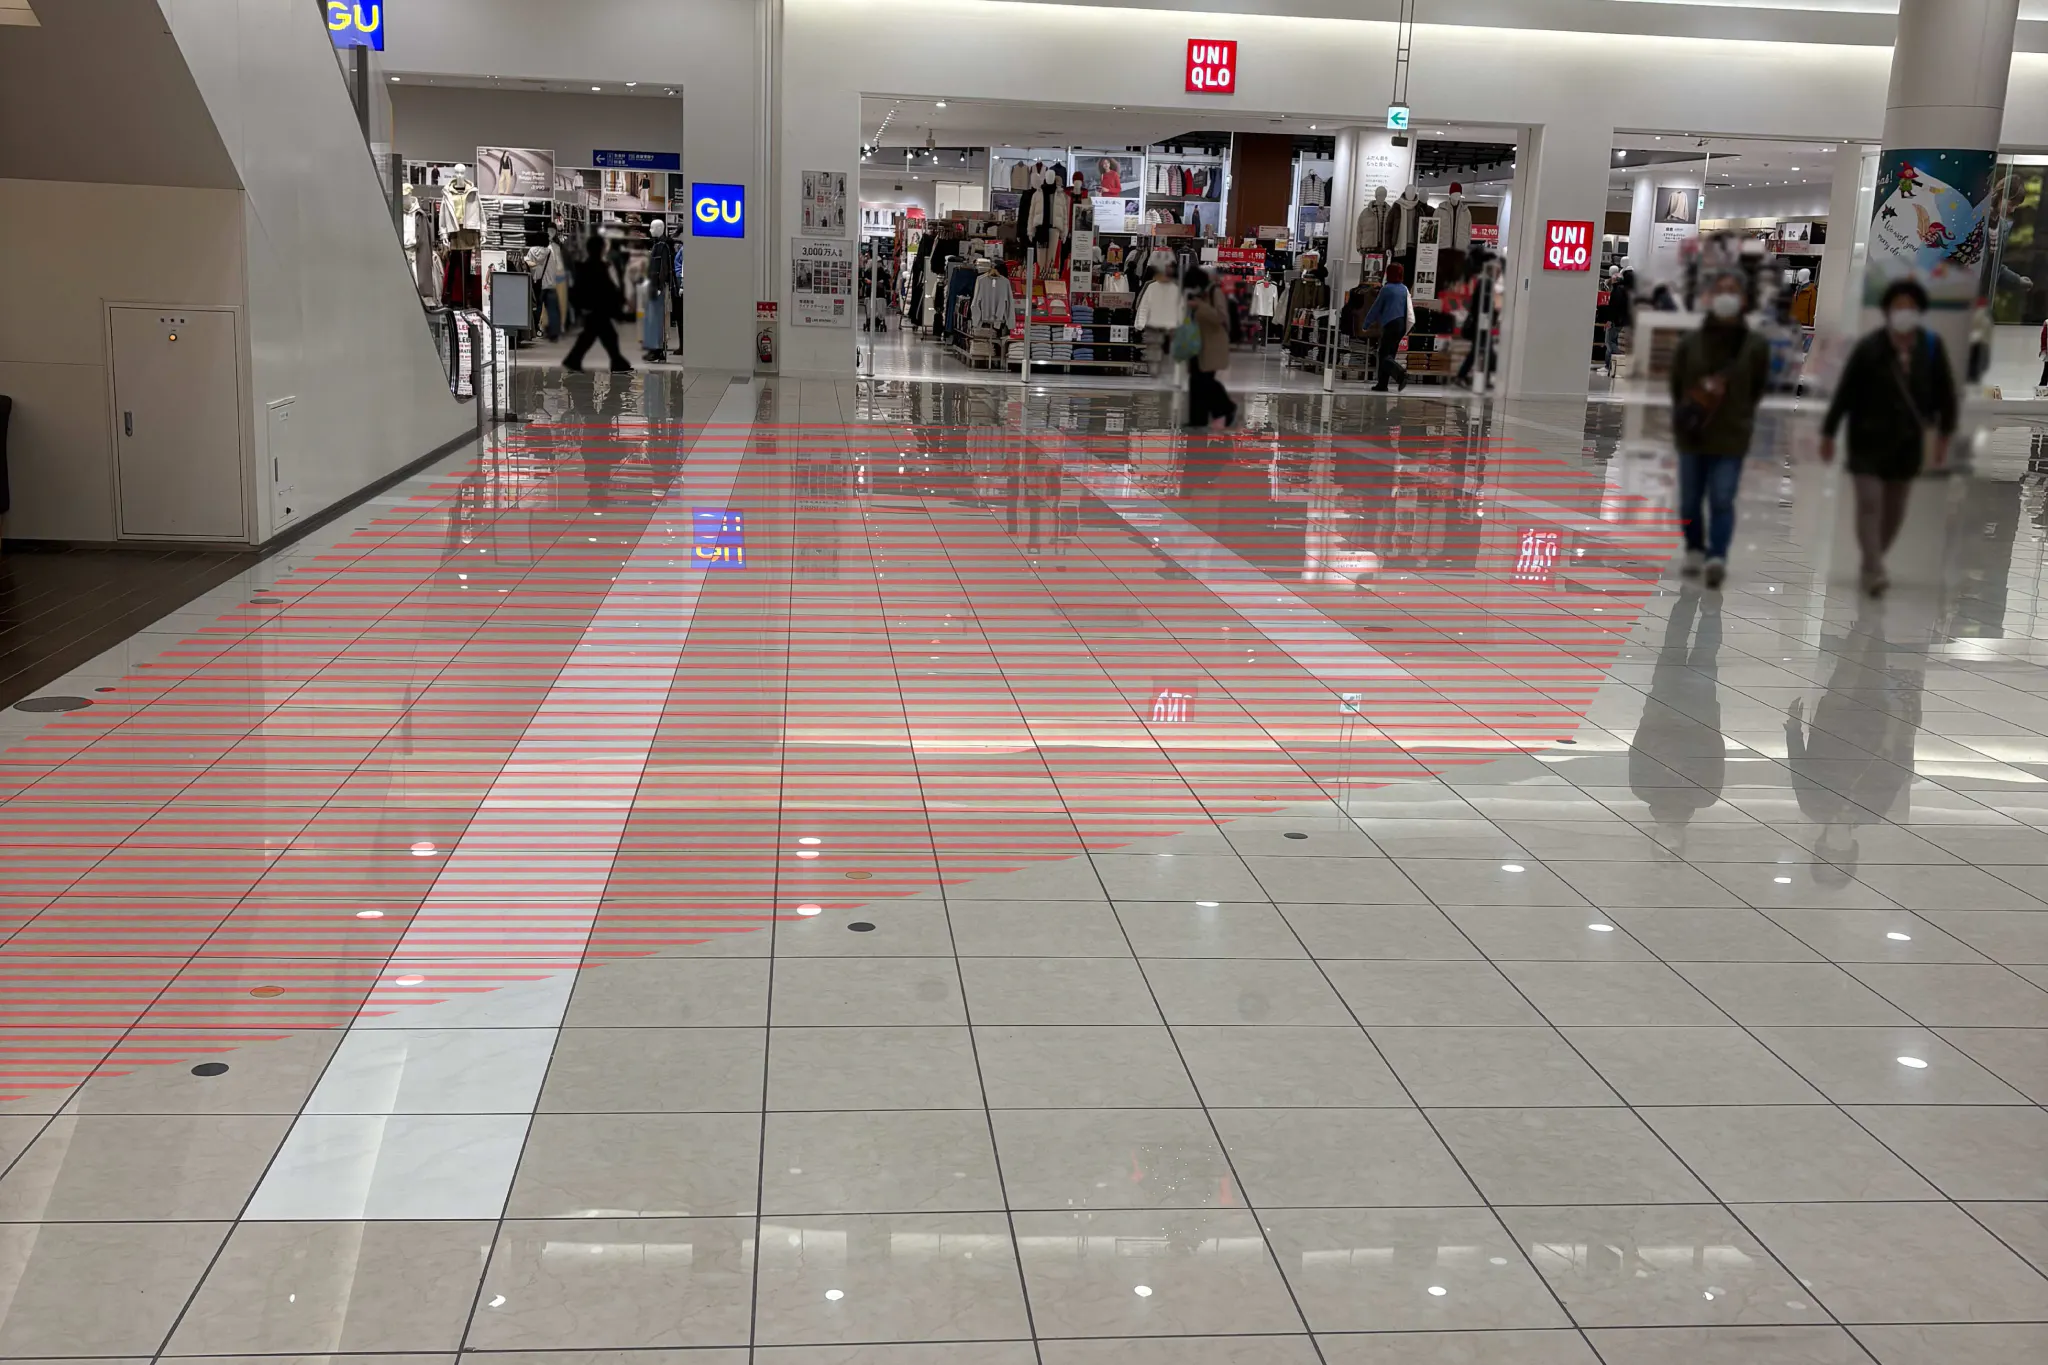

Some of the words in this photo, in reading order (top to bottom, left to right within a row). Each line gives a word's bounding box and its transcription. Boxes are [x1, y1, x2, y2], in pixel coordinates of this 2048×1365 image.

[328, 1, 379, 32] GU
[1192, 45, 1228, 66] UNI
[1190, 67, 1230, 89] QLO
[695, 197, 742, 224] GU
[1551, 226, 1586, 245] UNI
[1549, 246, 1587, 267] QLO
